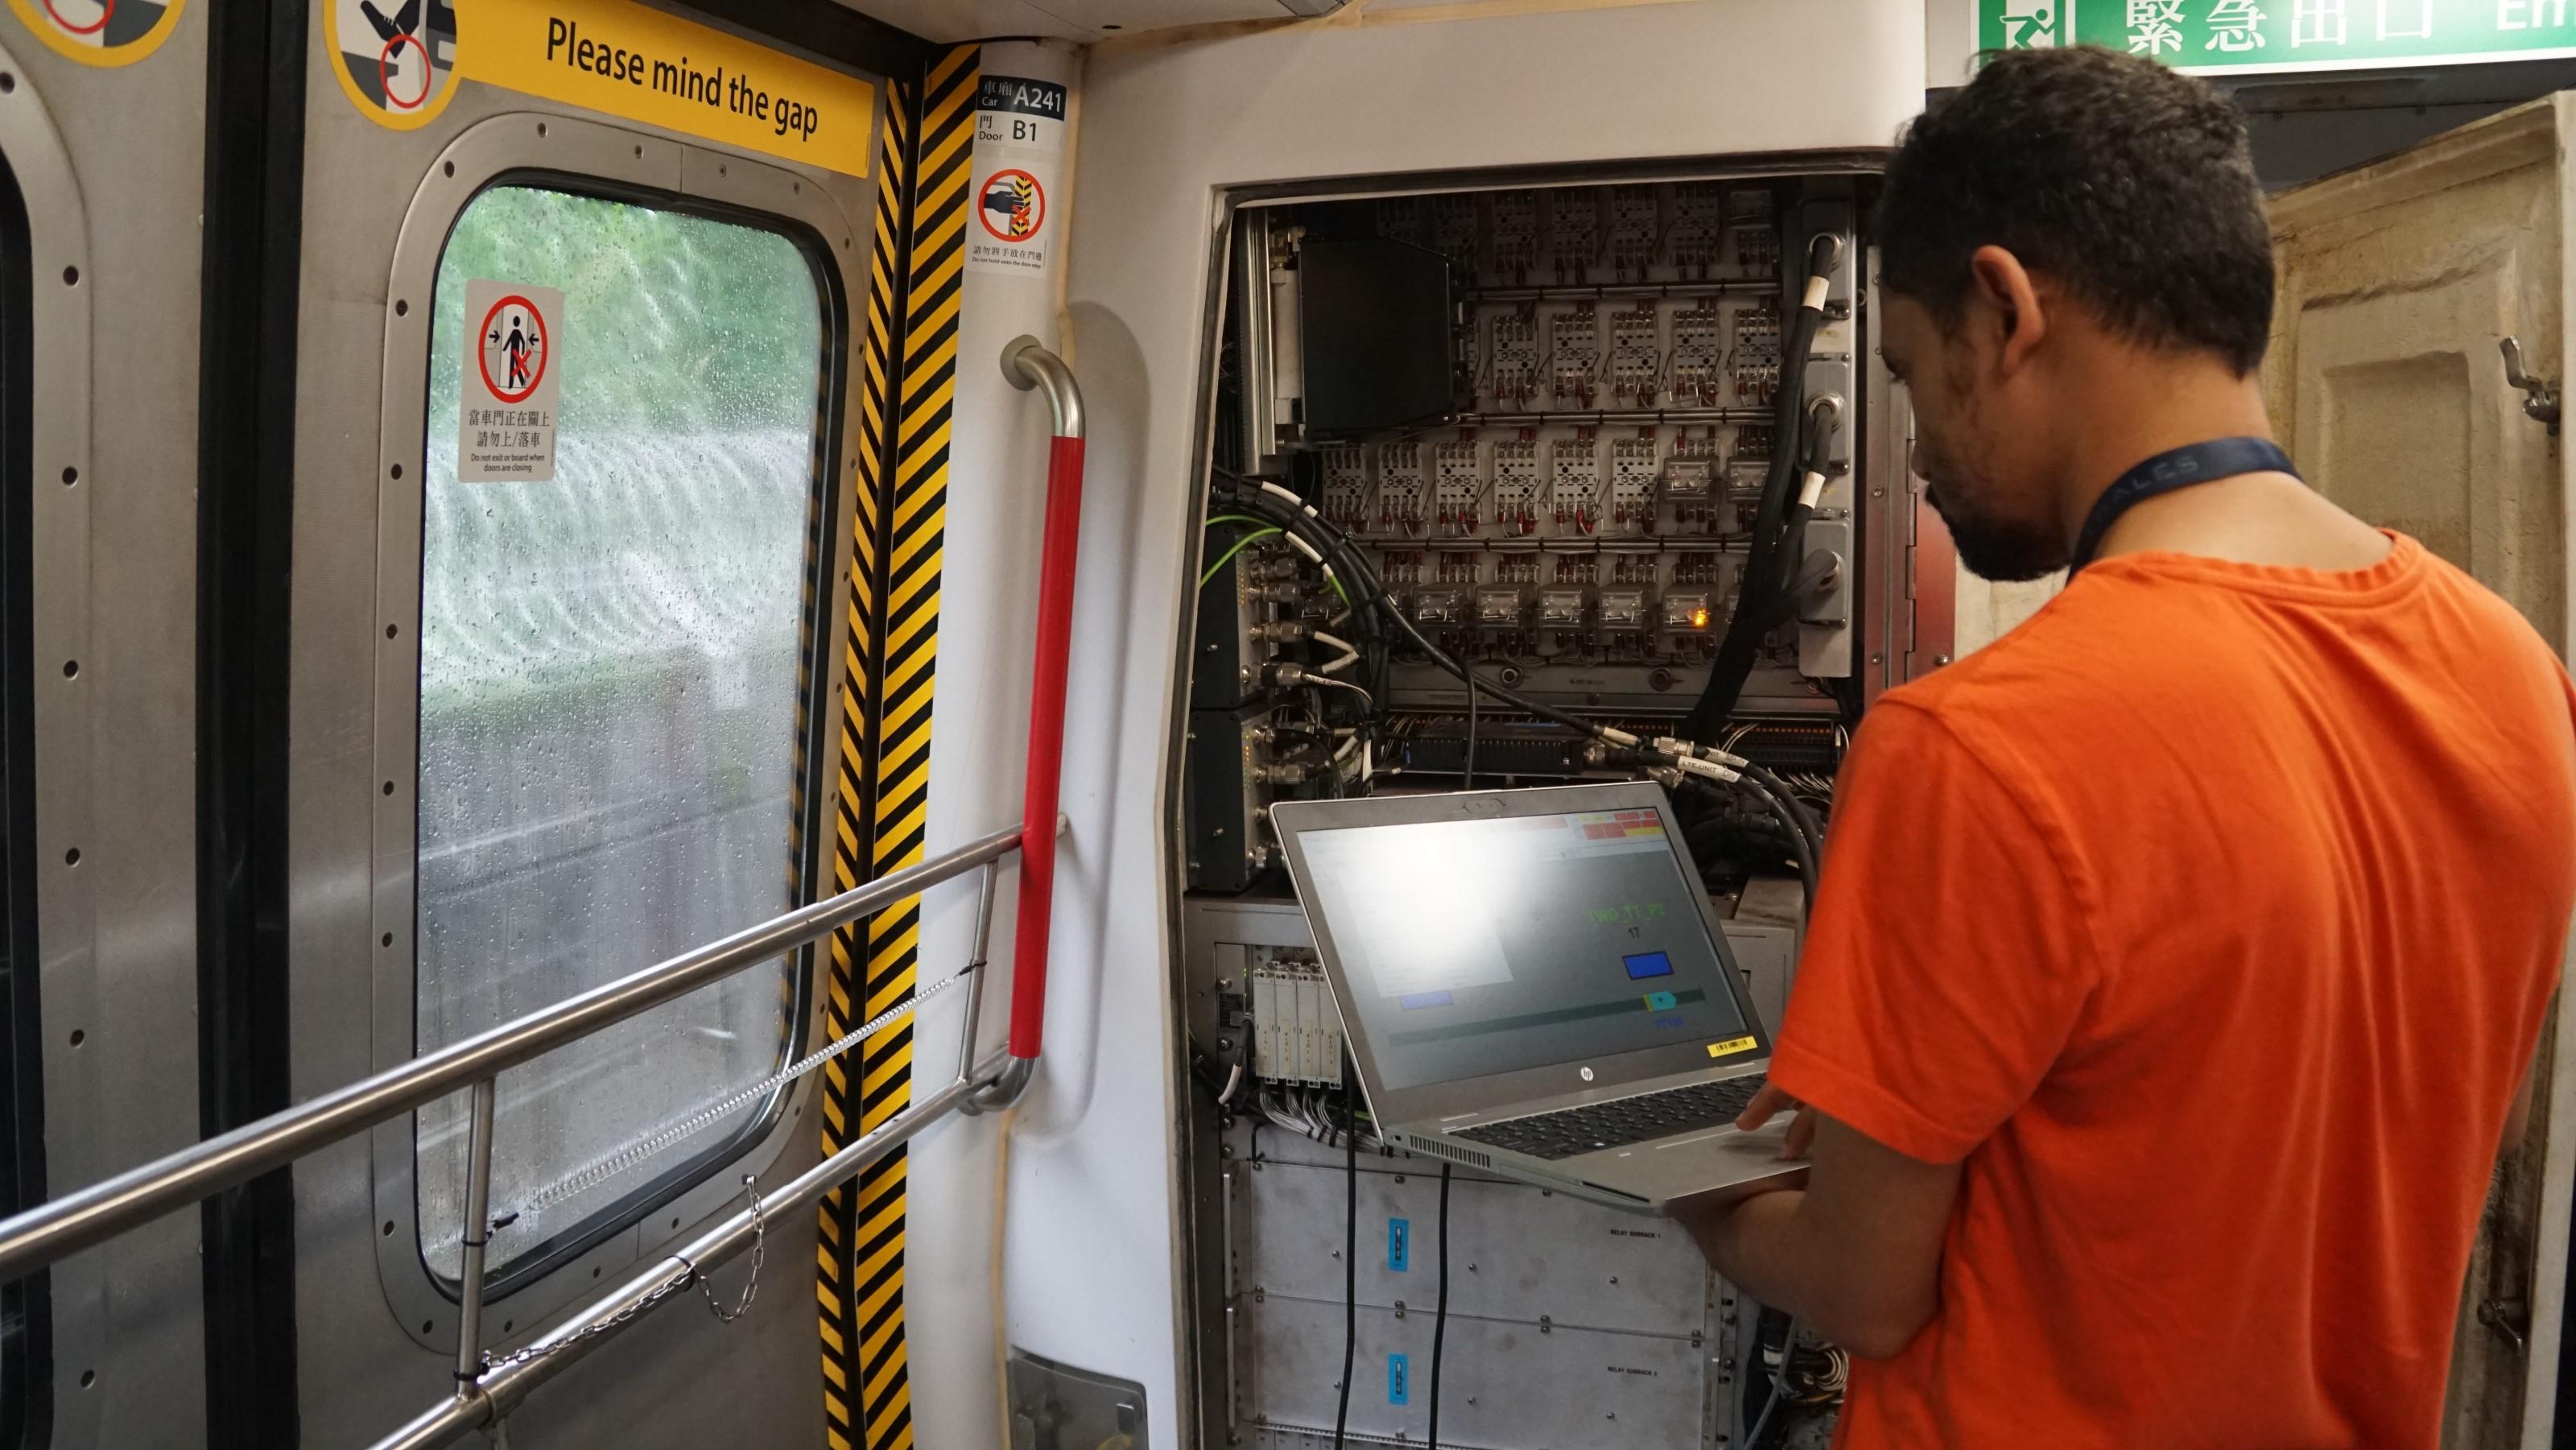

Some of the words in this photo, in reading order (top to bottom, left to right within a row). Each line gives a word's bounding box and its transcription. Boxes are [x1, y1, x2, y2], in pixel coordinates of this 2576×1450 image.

[2126, 0, 2432, 55] 緊急出口
[547, 17, 644, 85] Please
[653, 56, 722, 107] mind
[729, 74, 769, 121] the
[774, 97, 818, 143] gap
[985, 81, 1013, 97] 車廂
[981, 97, 998, 106] Car
[1013, 85, 1061, 113] A241
[980, 115, 993, 129] 門
[978, 130, 1003, 141] Door
[1013, 120, 1037, 142] B1
[469, 409, 550, 427] 當車門正在關上
[477, 431, 540, 448] 請勿上/落車
[471, 453, 480, 462] Do
[511, 453, 528, 461] board
[530, 453, 545, 461] when
[484, 464, 501, 472] doors
[512, 464, 532, 473] closing
[1582, 1067, 1593, 1081] hp
